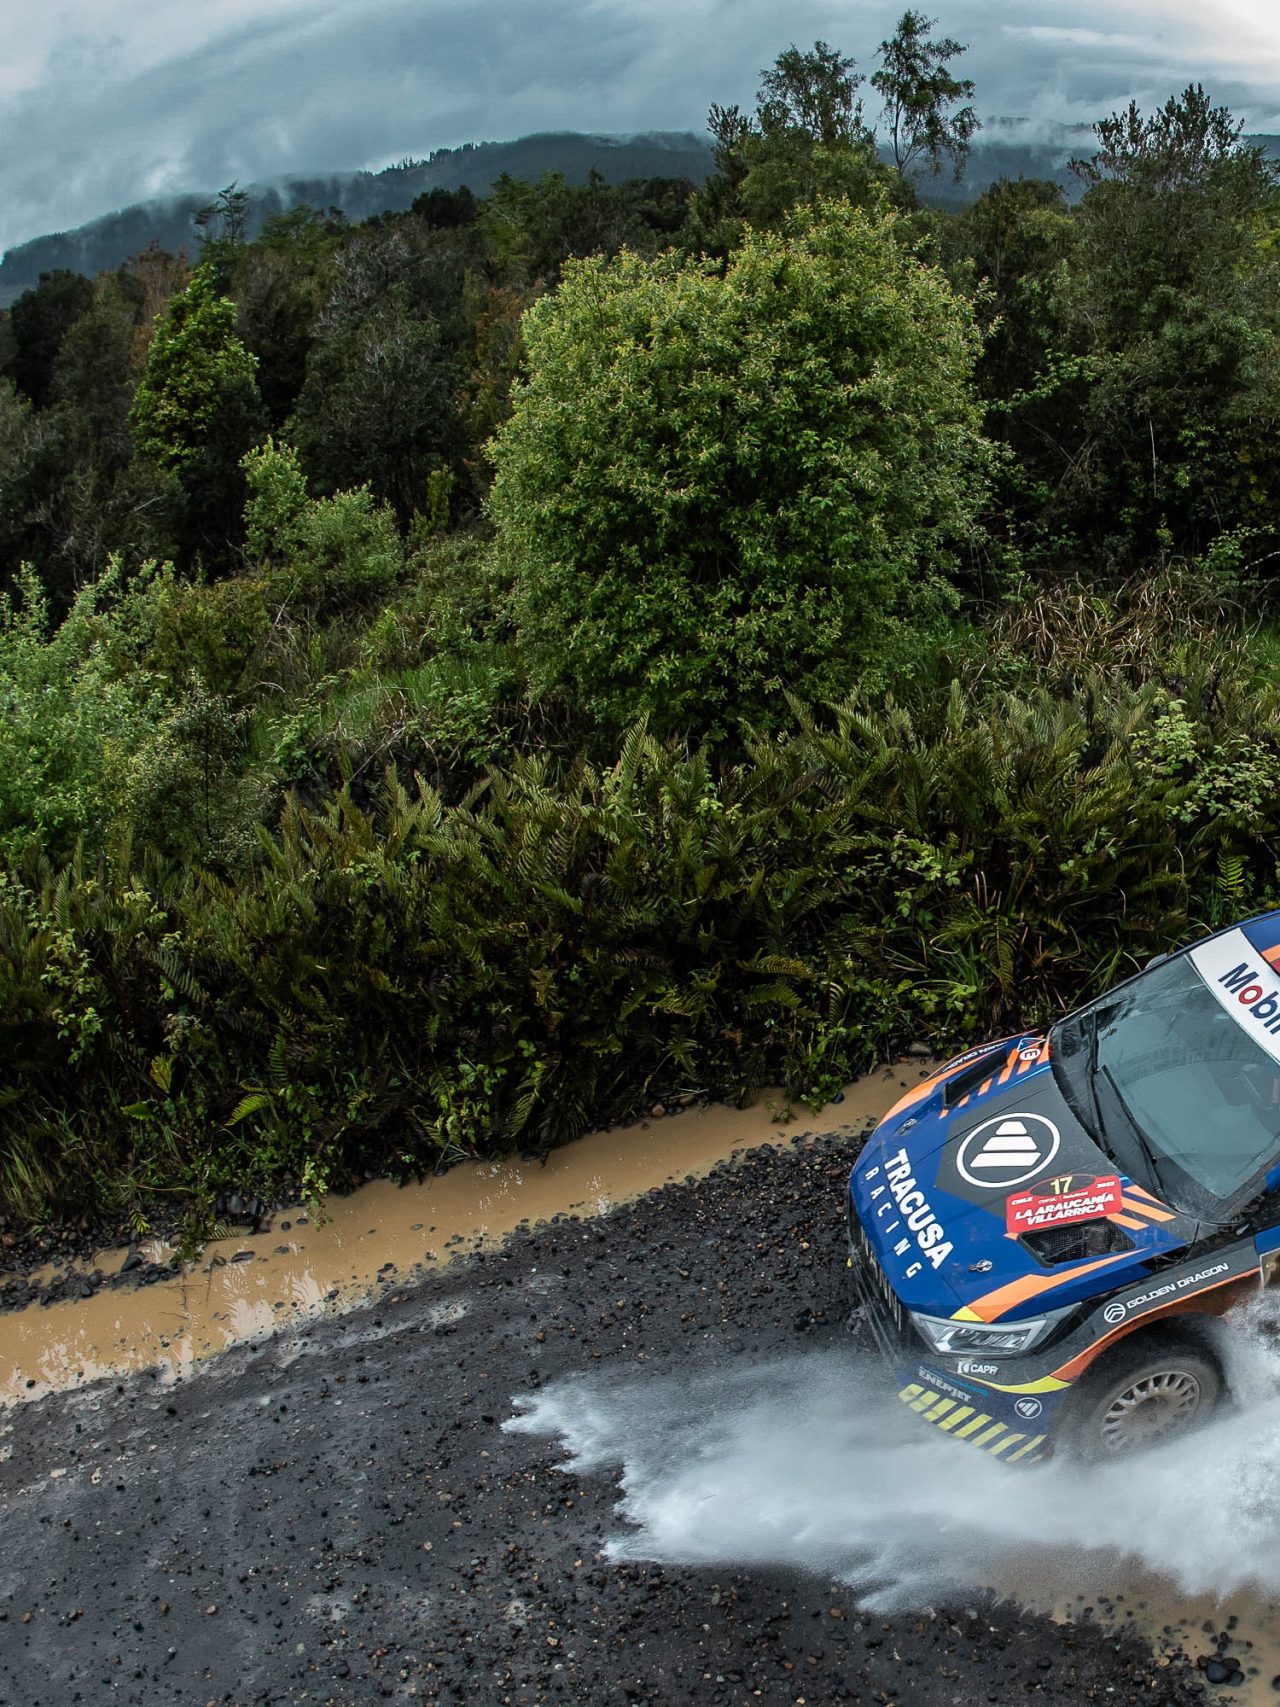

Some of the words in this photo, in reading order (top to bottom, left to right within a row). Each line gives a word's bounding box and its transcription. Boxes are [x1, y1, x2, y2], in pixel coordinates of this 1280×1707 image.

[1050, 1176, 1073, 1195] 17
[865, 1166, 922, 1278] RACING
[884, 1148, 954, 1270] TRACUSA
[1015, 1209, 1033, 1220] LA
[1027, 1204, 1105, 1225] VILLARRICA
[1126, 1284, 1176, 1309] GOLDEN
[1177, 1262, 1229, 1288] DRAGON
